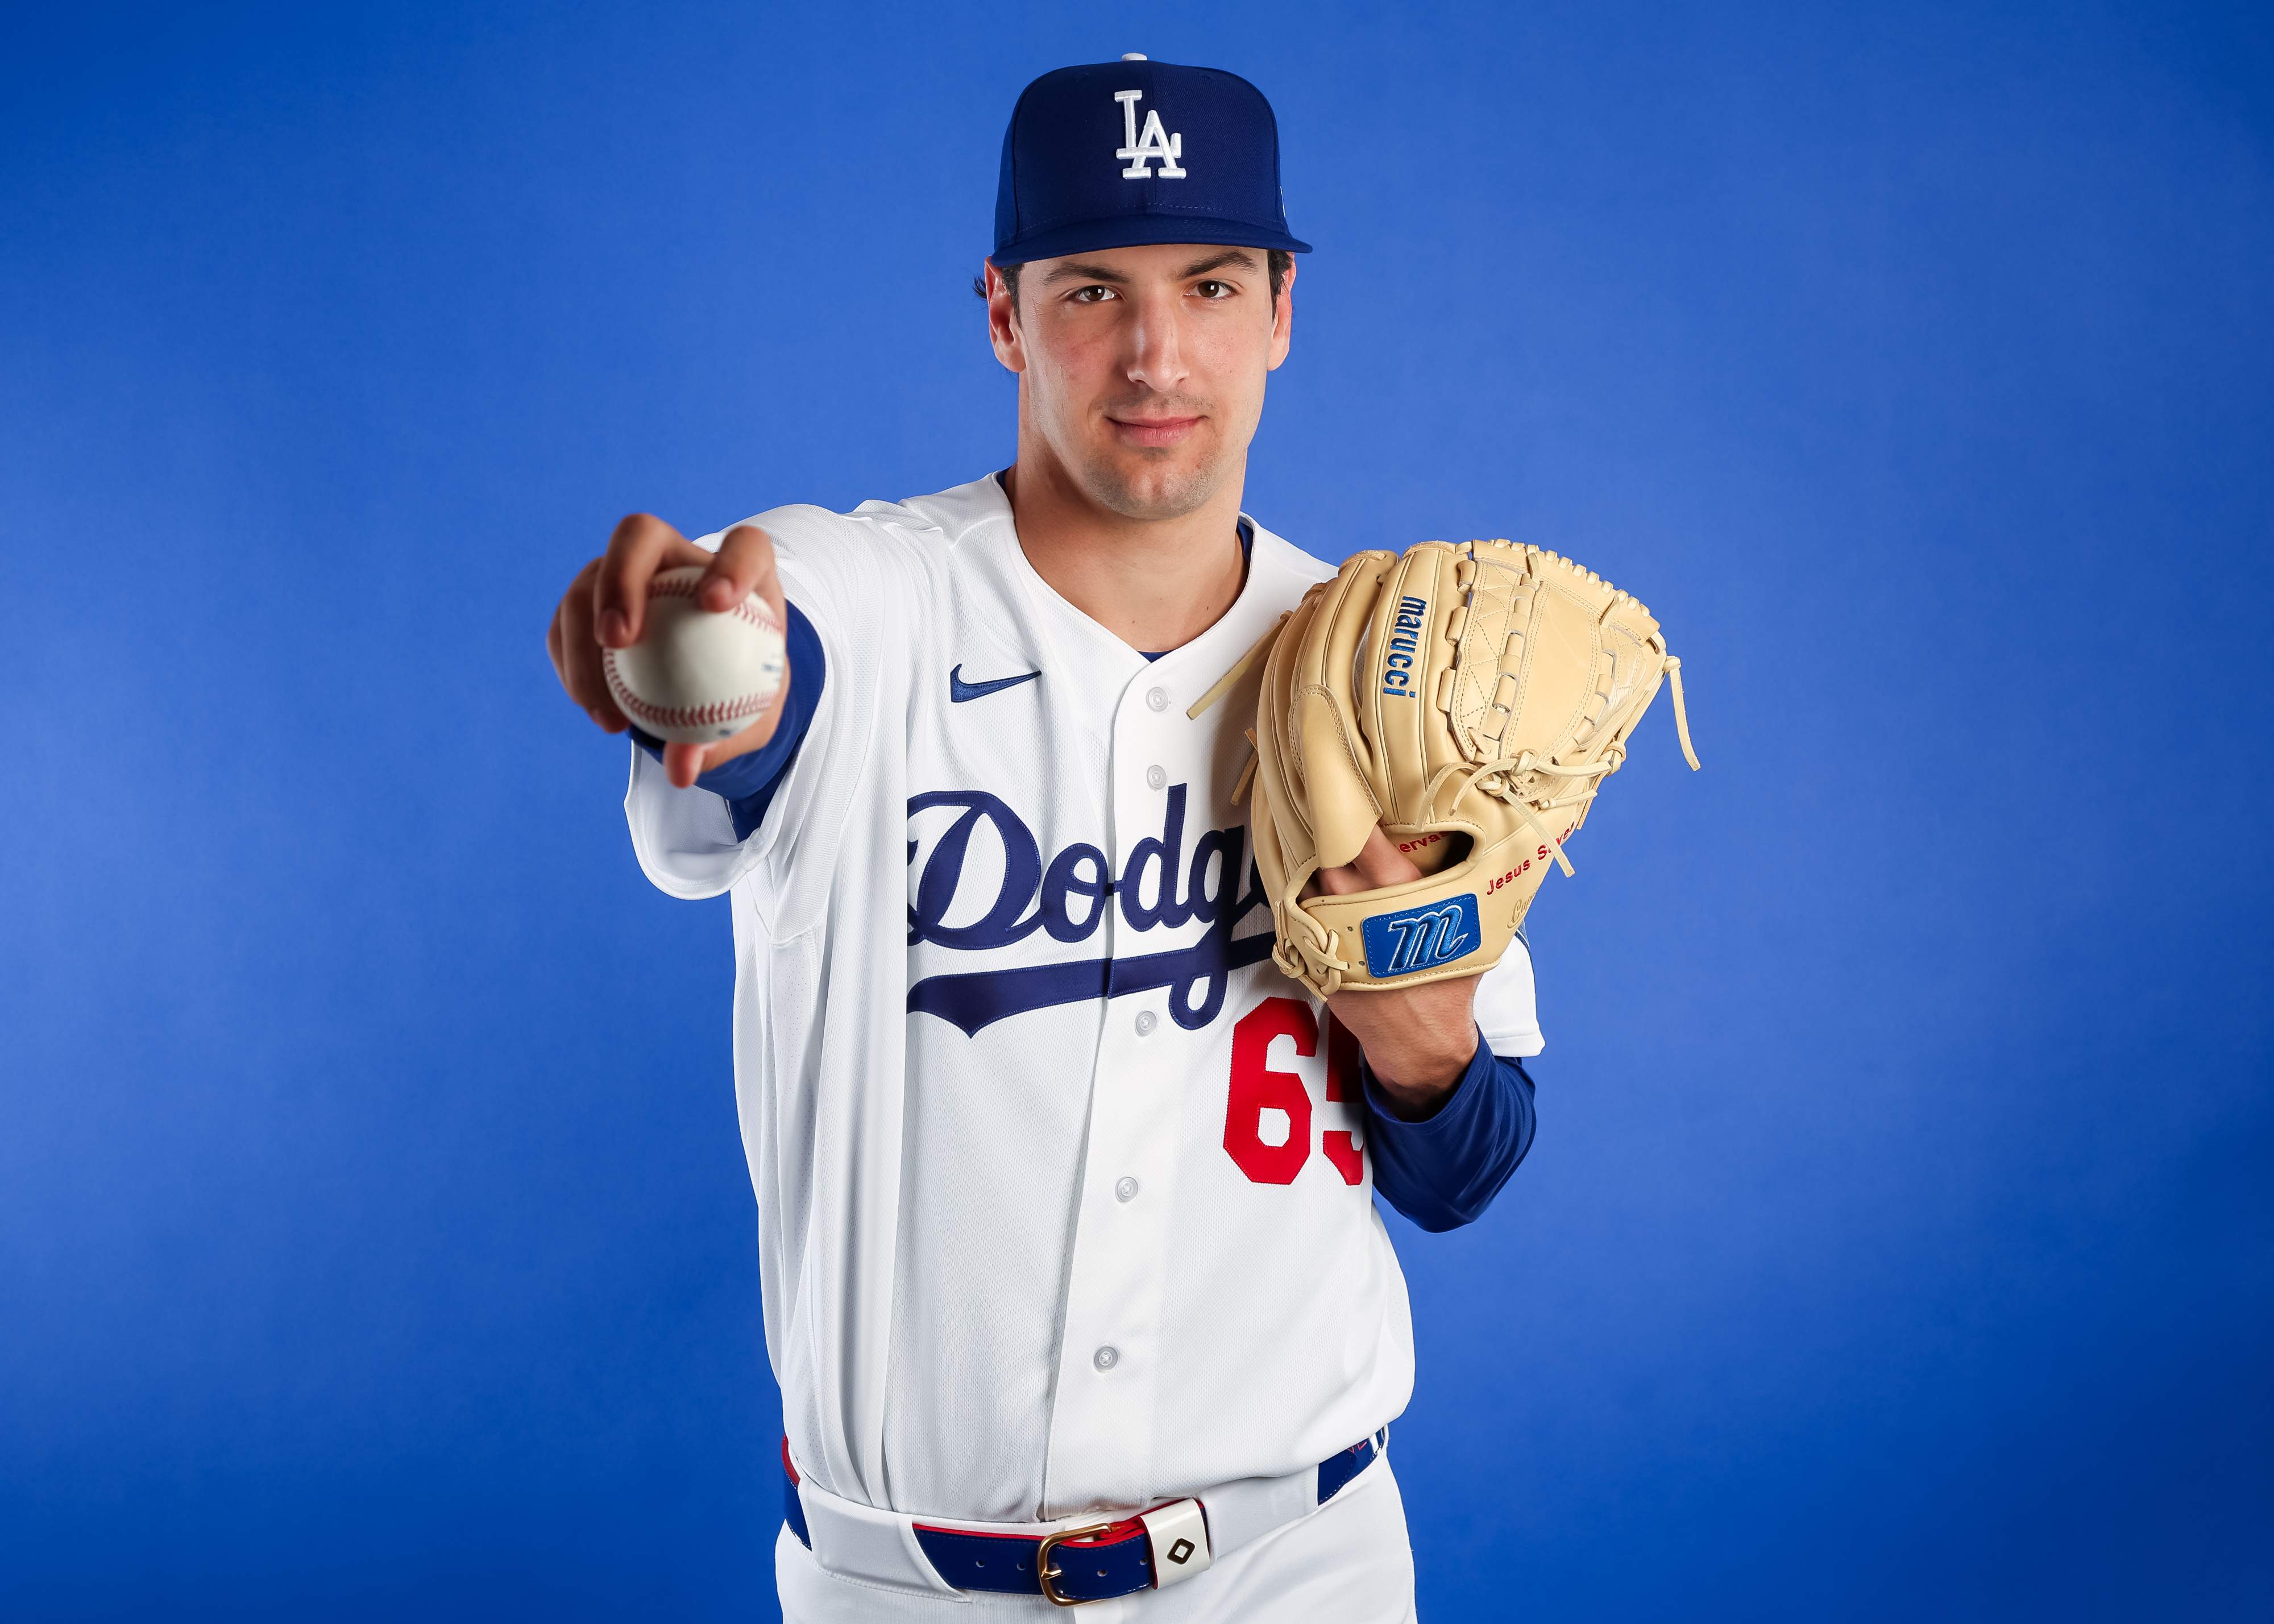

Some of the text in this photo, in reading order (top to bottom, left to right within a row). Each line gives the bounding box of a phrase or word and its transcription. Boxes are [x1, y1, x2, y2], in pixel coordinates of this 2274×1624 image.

[1114, 90, 1187, 180] LA
[1383, 596, 1427, 698] marucci
[1487, 821, 1575, 895] Jesus Sve
